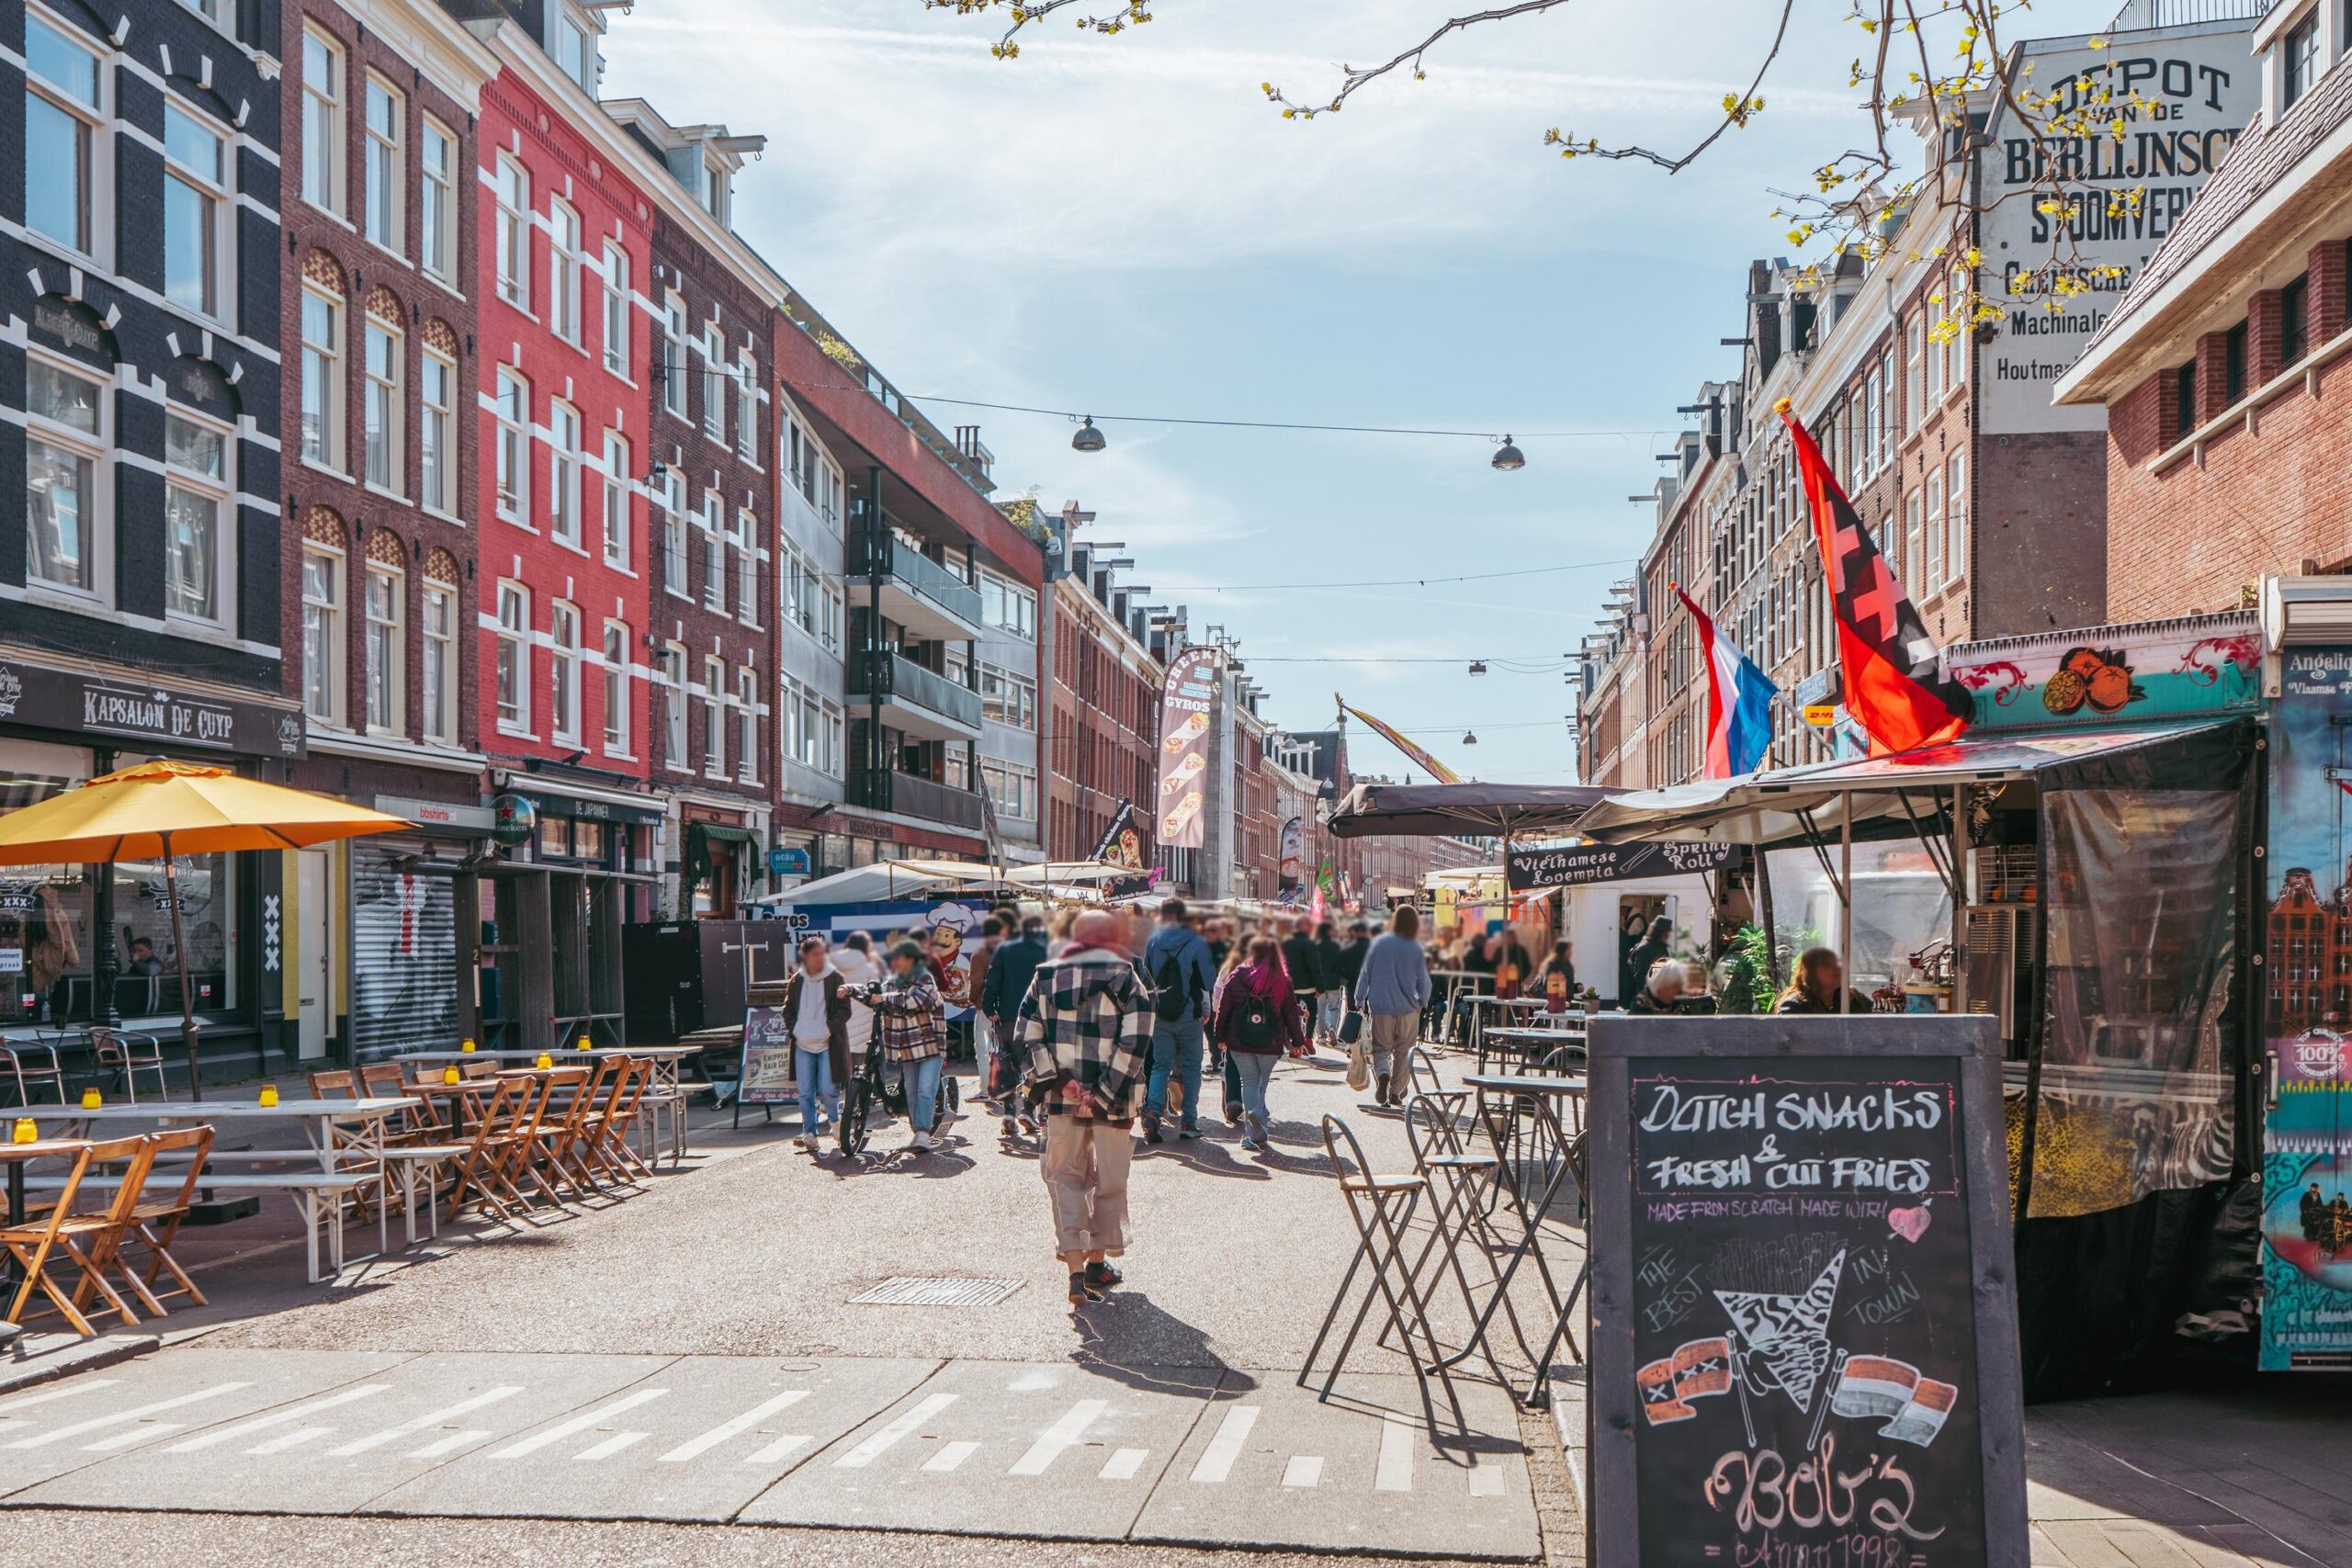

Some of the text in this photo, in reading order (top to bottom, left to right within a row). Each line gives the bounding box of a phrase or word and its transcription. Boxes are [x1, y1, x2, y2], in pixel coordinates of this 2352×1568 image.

[2052, 57, 2230, 121] DEPOT
[2154, 103, 2184, 121] DE
[1166, 649, 1213, 691] GREEK
[2287, 682, 2336, 694] Vlaamse
[1164, 696, 1211, 713] GYROS
[775, 853, 795, 862] OCHO
[1663, 840, 1731, 861] Spring
[1668, 853, 1713, 871] Roll
[1532, 865, 1614, 886] Loempia
[2298, 1031, 2311, 1043] TOP
[2296, 1046, 2345, 1061] 100%
[1775, 1088, 1941, 1132] SNACKS
[1753, 1134, 1786, 1162] &
[1646, 1154, 1751, 1189] FRESH
[1766, 1158, 1826, 1189] CUT
[1647, 1202, 1690, 1223] MADE
[1690, 1201, 1729, 1219] FROM
[1732, 1198, 1792, 1217] SCRATCH
[1800, 1199, 1842, 1218] MADE
[1638, 1249, 1677, 1287] THE
[1851, 1248, 1883, 1284] IN
[1845, 1271, 1920, 1325] TOWN
